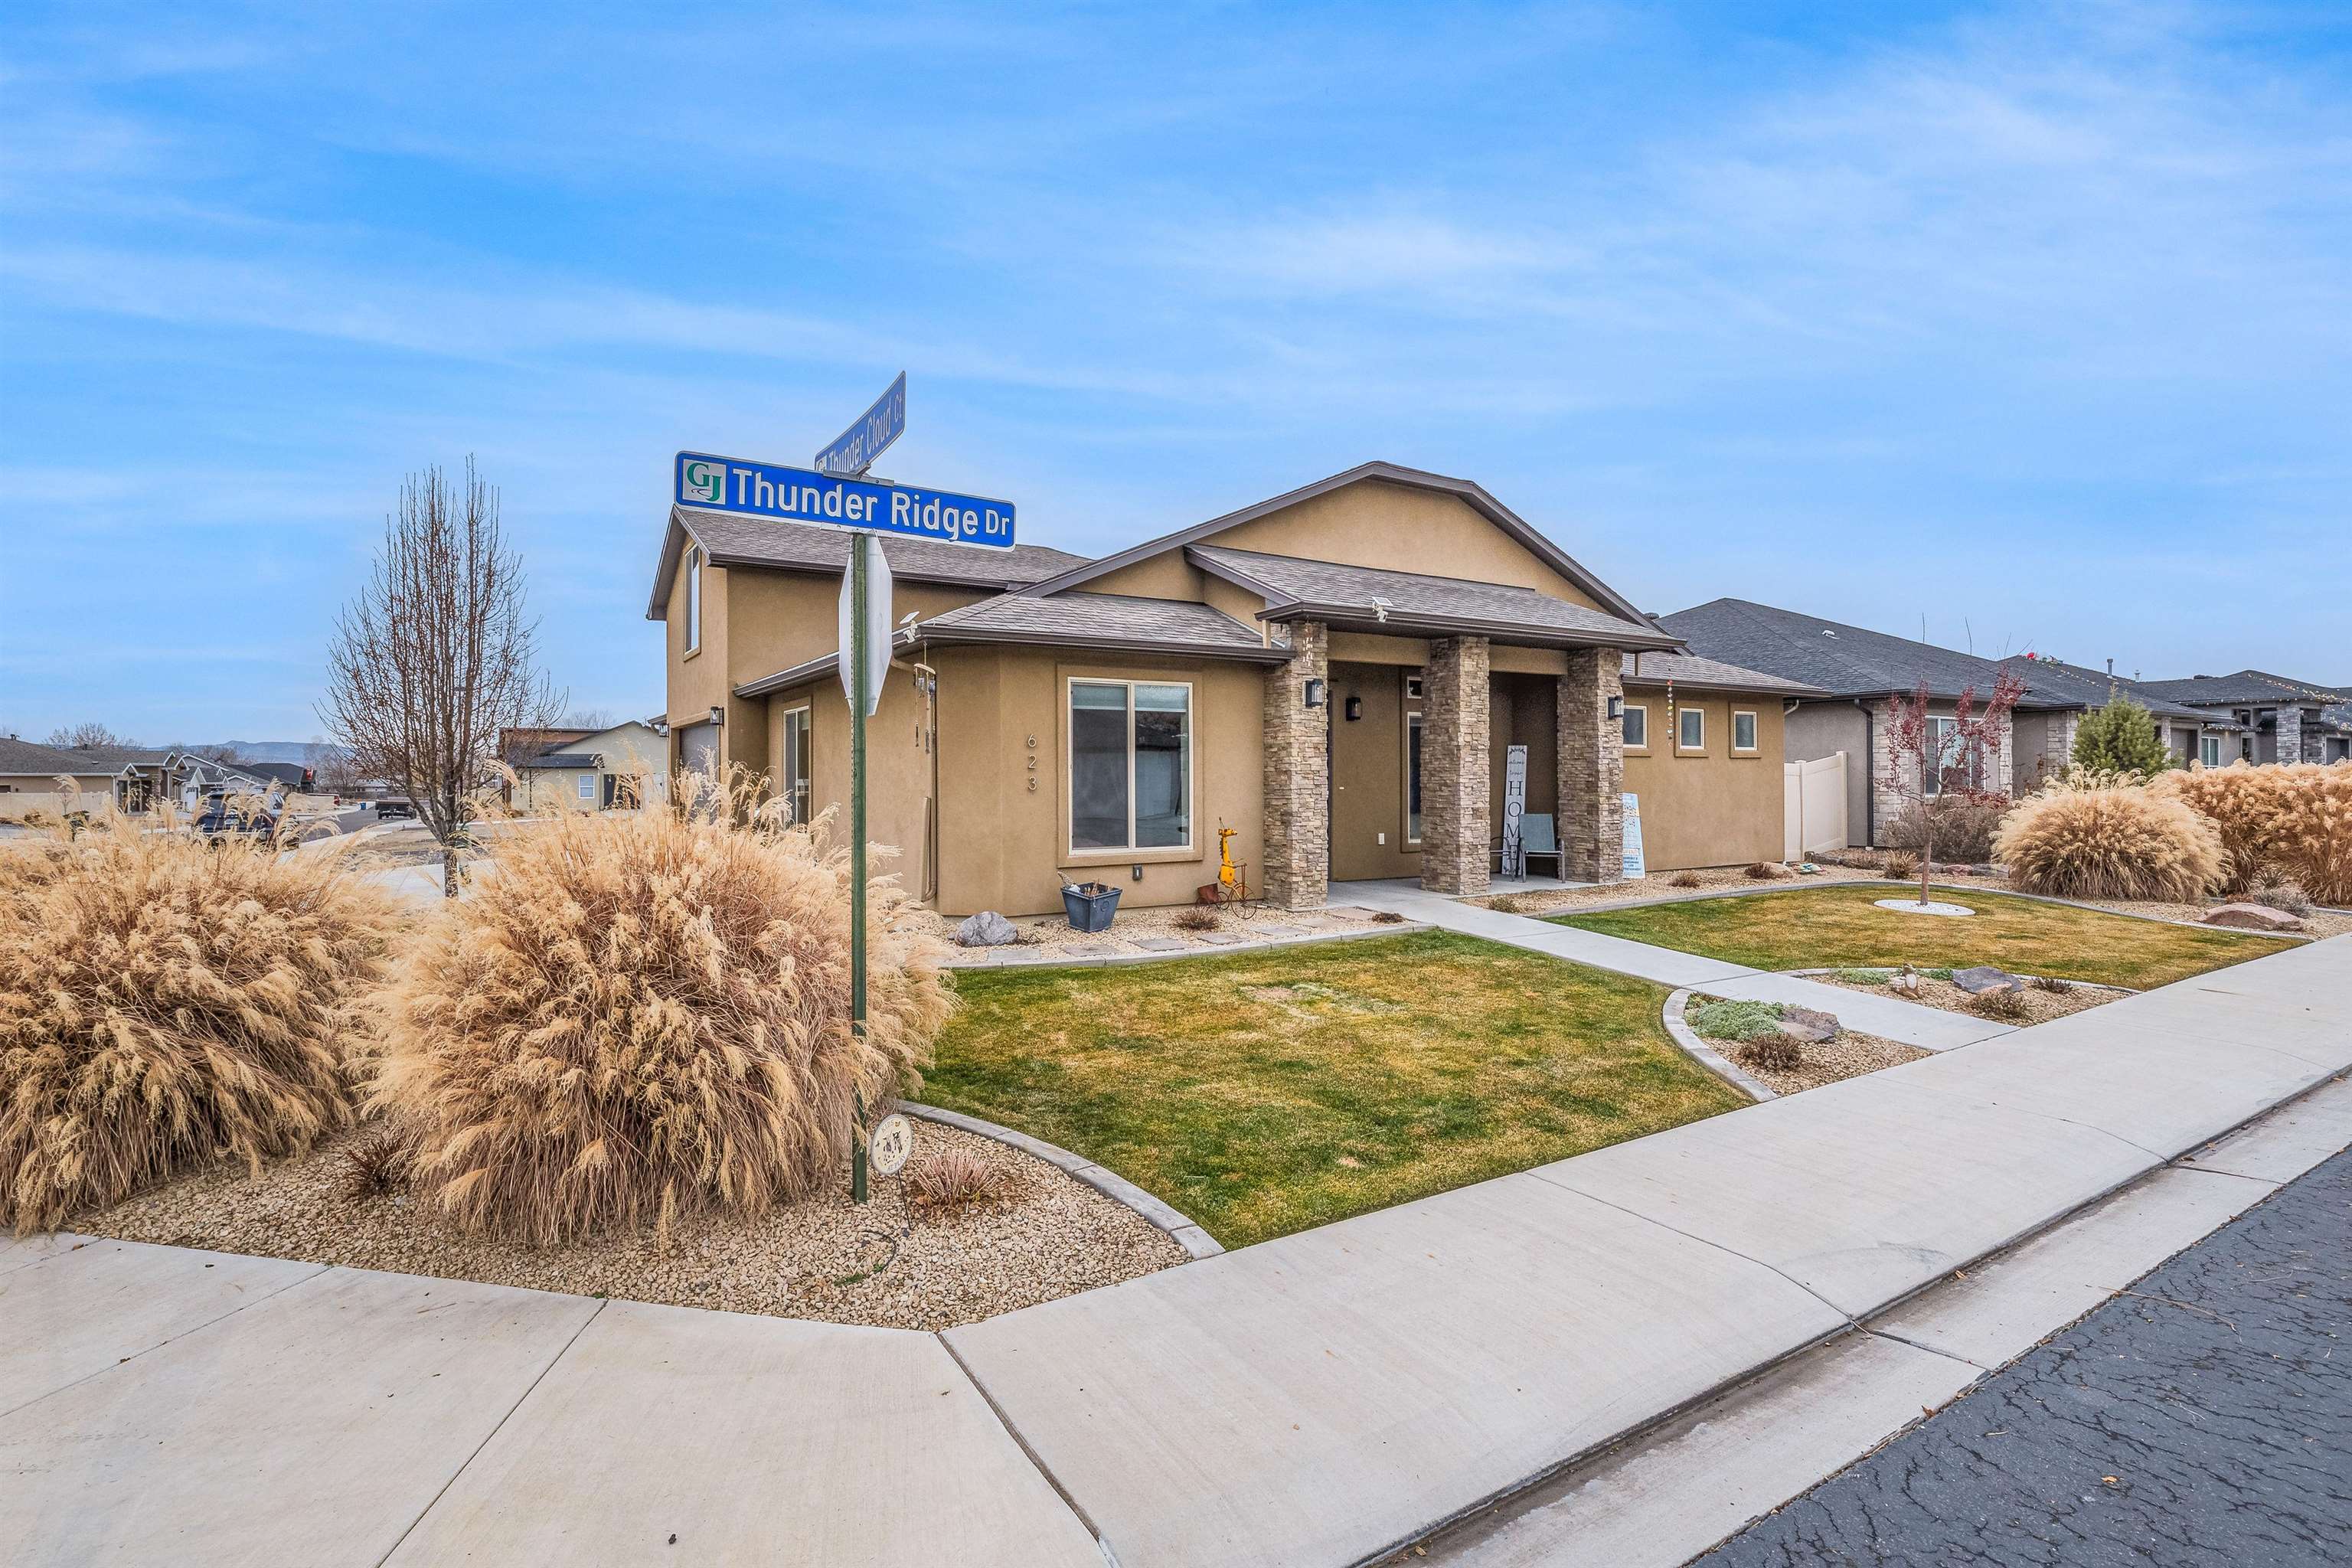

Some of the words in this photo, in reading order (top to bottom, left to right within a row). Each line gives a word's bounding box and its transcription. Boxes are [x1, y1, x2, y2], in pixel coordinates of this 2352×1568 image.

[828, 432, 864, 472] Thunder
[867, 397, 891, 455] Cloud
[894, 392, 902, 423] Ct
[686, 462, 721, 501] GJ
[733, 468, 878, 522] Thunder
[891, 491, 978, 541] Ridge
[985, 508, 1010, 536] Dr
[1027, 733, 1037, 790] 623
